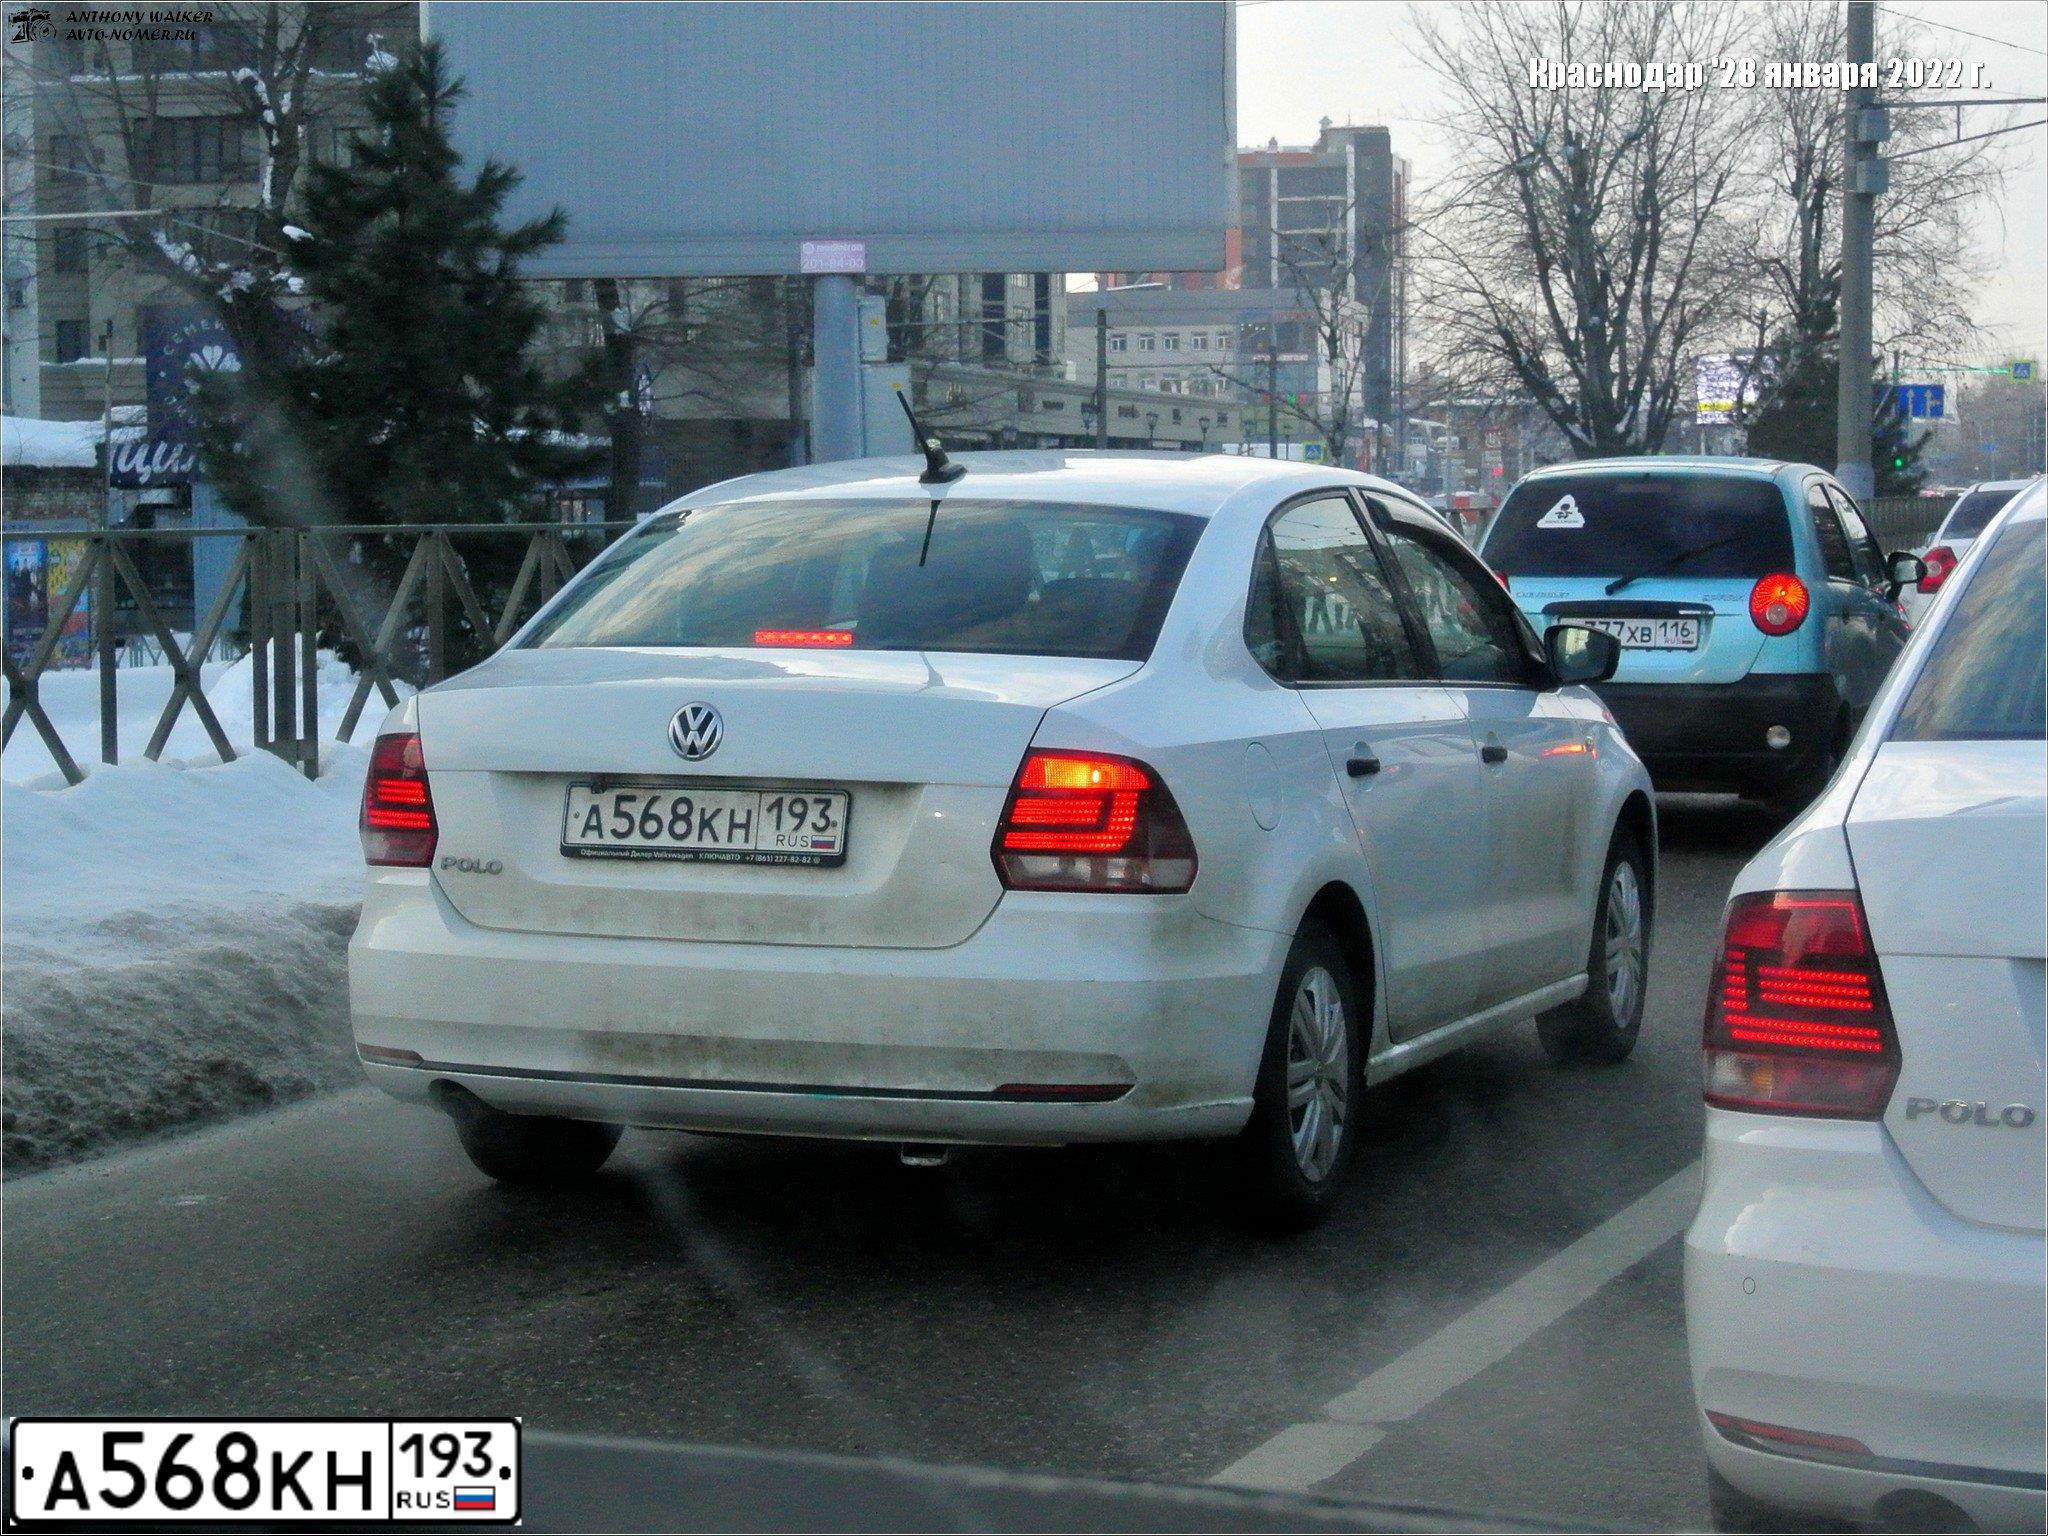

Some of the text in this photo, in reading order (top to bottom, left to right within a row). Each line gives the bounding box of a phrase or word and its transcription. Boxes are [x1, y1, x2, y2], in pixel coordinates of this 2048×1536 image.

[1659, 621, 1691, 638] 116
[580, 794, 832, 844] А568КН 193
[775, 834, 809, 848] RUS
[440, 856, 503, 876] POLO
[1905, 1097, 2036, 1128] POLO
